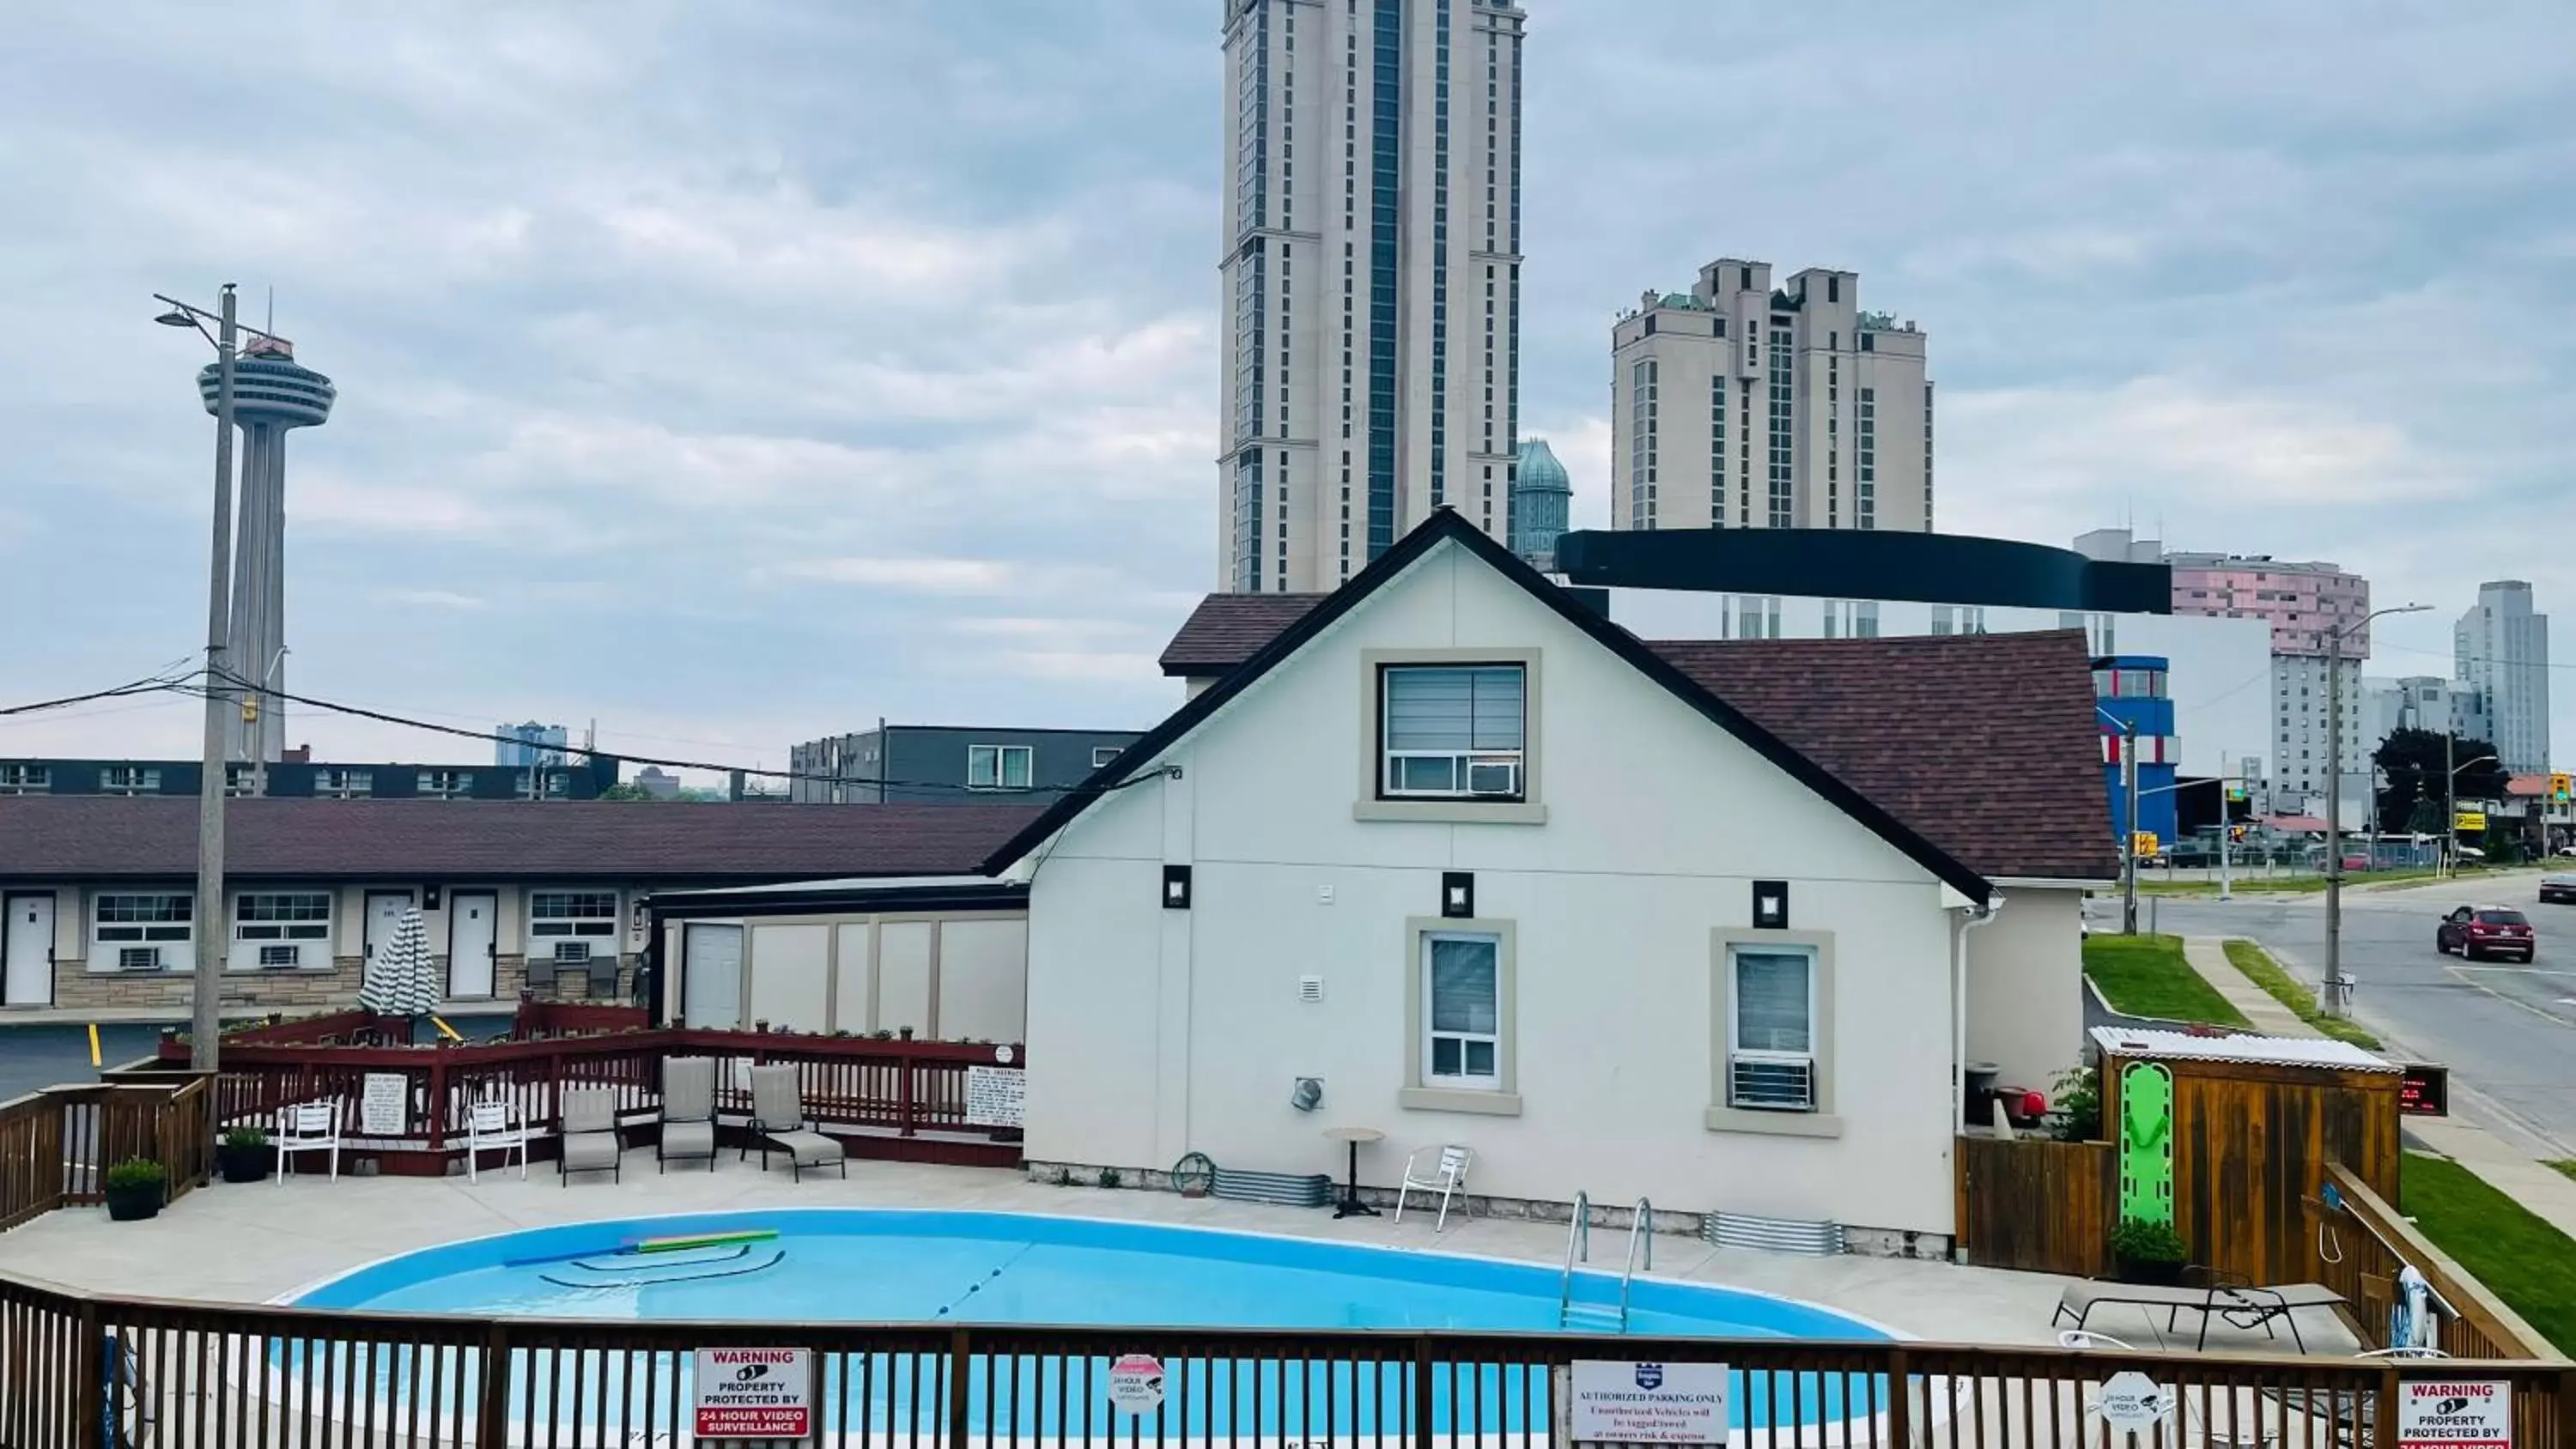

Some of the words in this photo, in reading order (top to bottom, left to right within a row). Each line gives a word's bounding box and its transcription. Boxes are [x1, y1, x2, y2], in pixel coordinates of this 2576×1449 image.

[714, 1352, 794, 1364] WARNING
[719, 1382, 785, 1391] PROPERTY
[2412, 1385, 2494, 1397] WARNING
[705, 1395, 779, 1404] PROTECTED
[783, 1395, 799, 1404] BY
[1581, 1392, 1646, 1402] AUTHORIZED
[1649, 1393, 1694, 1403] PARKING
[1696, 1393, 1723, 1404] ONLY
[700, 1411, 716, 1421] 24
[720, 1411, 759, 1421] HOUR
[763, 1411, 804, 1421] VIDEO
[2419, 1416, 2486, 1426] PROPERTY
[708, 1422, 796, 1432] SURVEILLANCE
[2404, 1428, 2479, 1438] PROTECTED
[2482, 1428, 2500, 1438] BY
